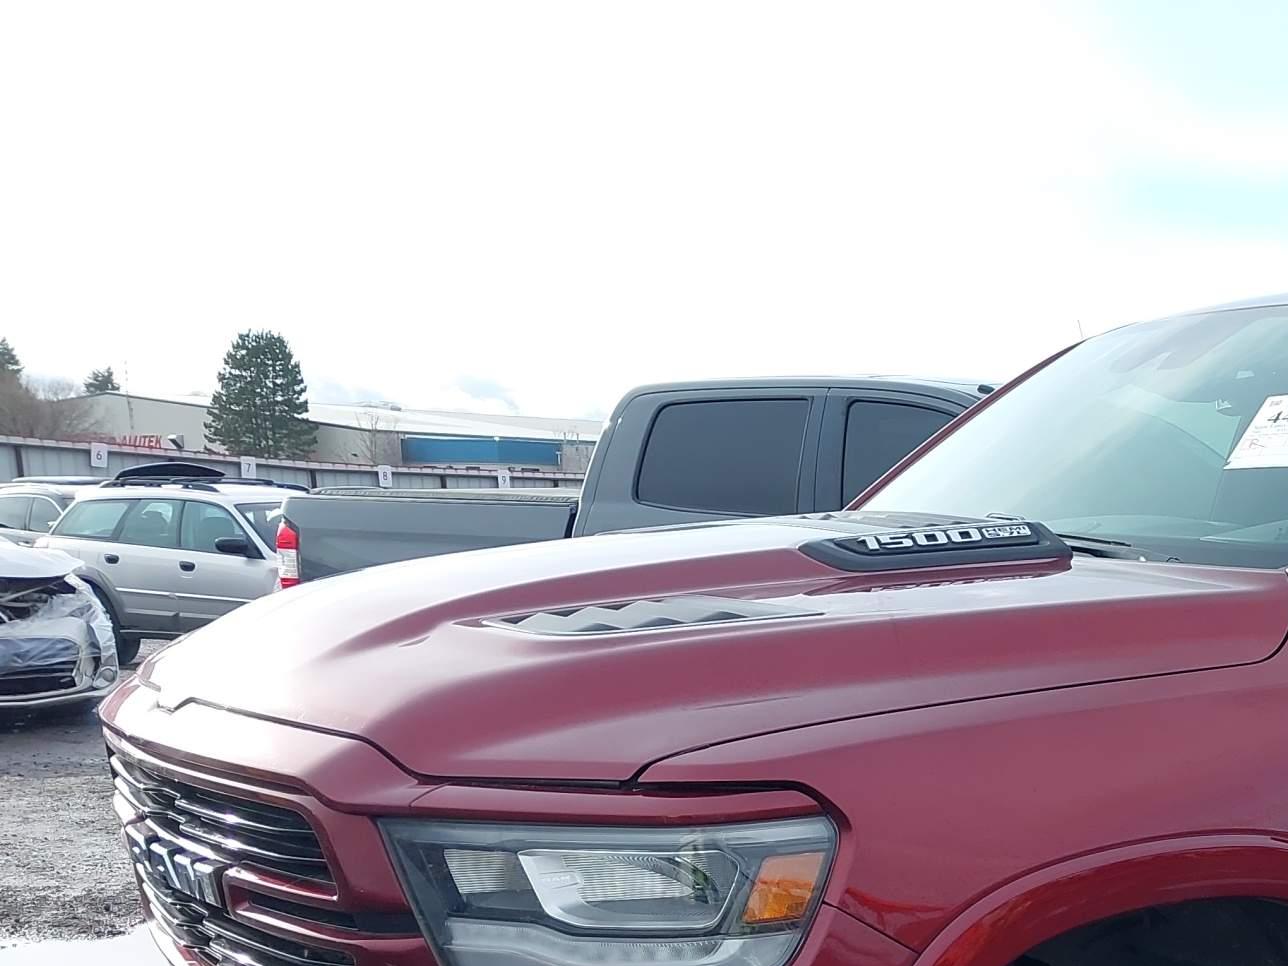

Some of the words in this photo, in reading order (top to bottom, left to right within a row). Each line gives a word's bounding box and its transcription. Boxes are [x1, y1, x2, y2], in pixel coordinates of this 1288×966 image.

[96, 451, 102, 460] 6
[244, 463, 251, 472] 7
[382, 471, 388, 480] 8
[856, 527, 982, 551] 1500
